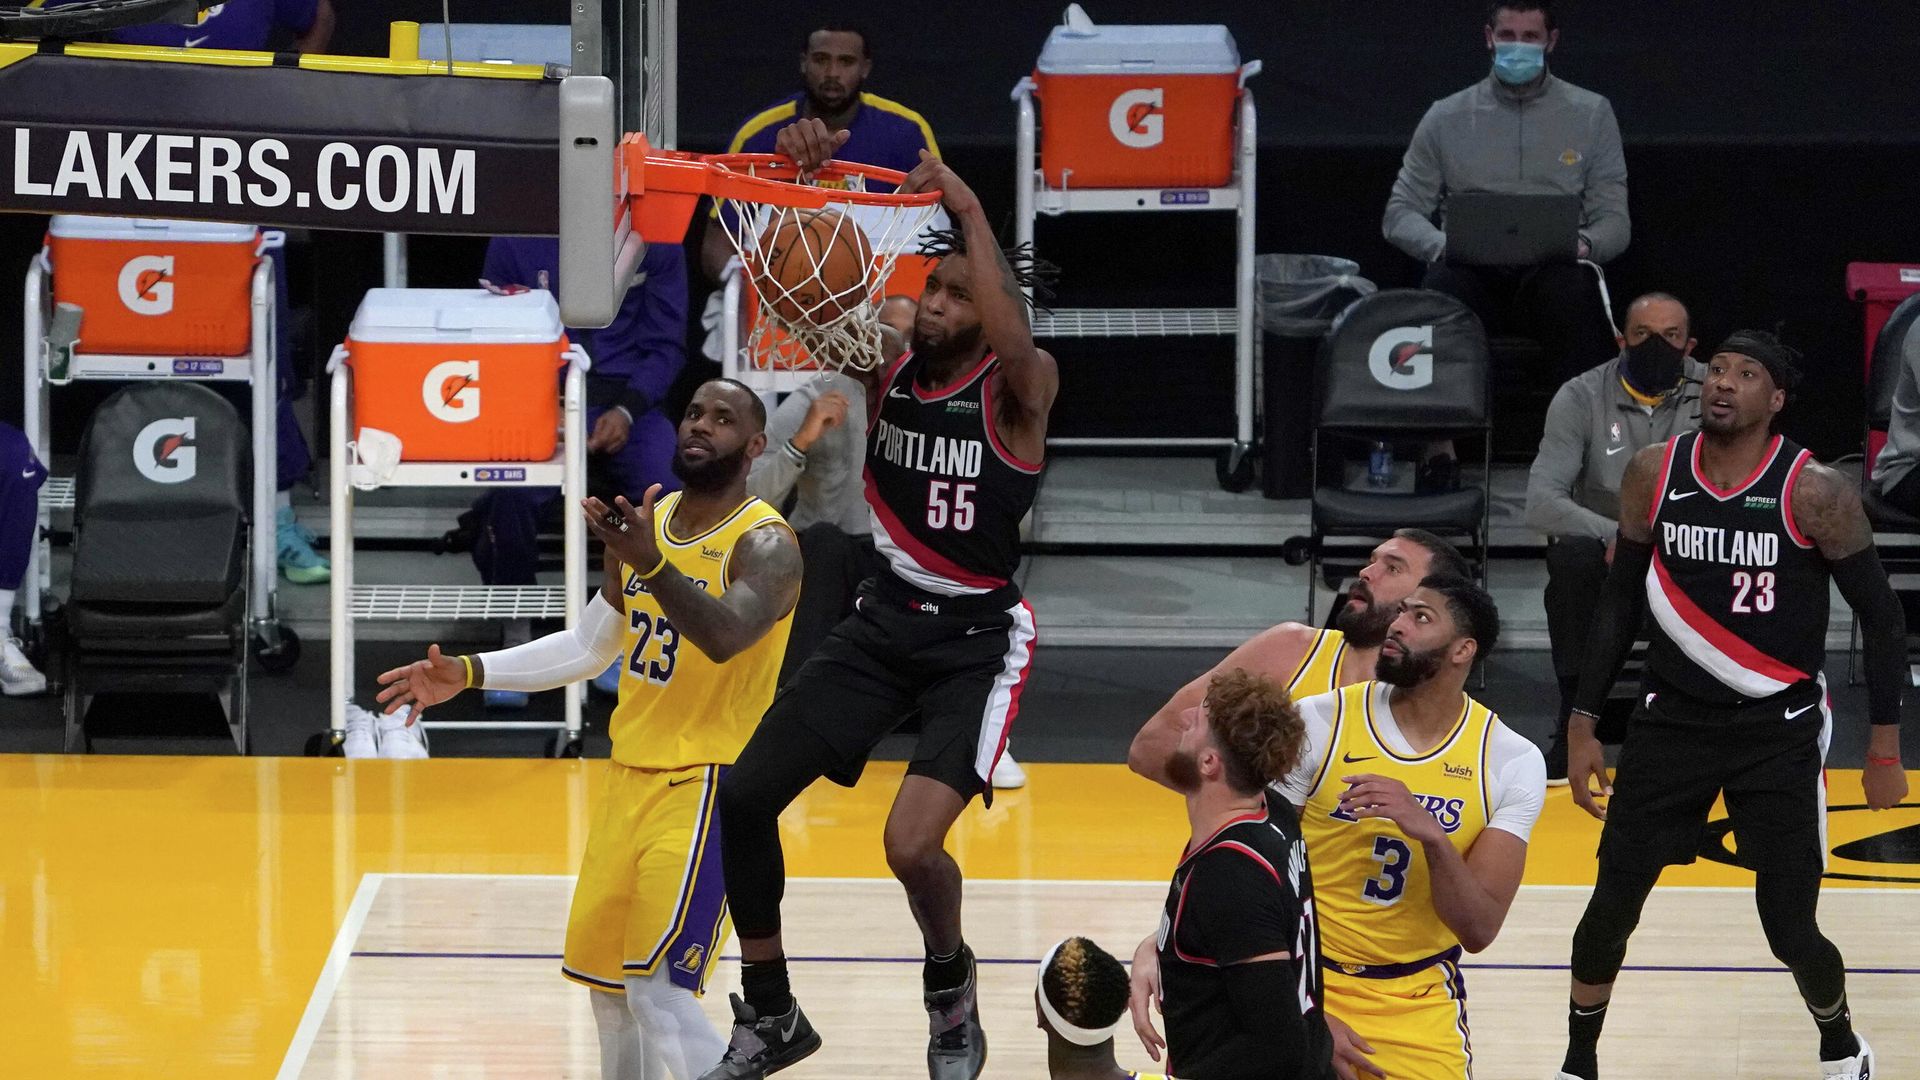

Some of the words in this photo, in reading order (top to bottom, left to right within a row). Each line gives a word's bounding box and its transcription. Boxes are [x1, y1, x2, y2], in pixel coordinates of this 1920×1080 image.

[1109, 87, 1164, 148] G
[14, 127, 476, 215] LAKERS.COM
[118, 255, 174, 315] G
[1369, 325, 1433, 390] G
[422, 360, 480, 422] G
[133, 417, 197, 484] G
[874, 418, 983, 478] PORTLAND
[927, 481, 977, 531] 55
[1661, 521, 1779, 567] PORTLAND
[1732, 571, 1776, 613] 23
[628, 608, 681, 687] 23
[1361, 836, 1412, 907] 3
